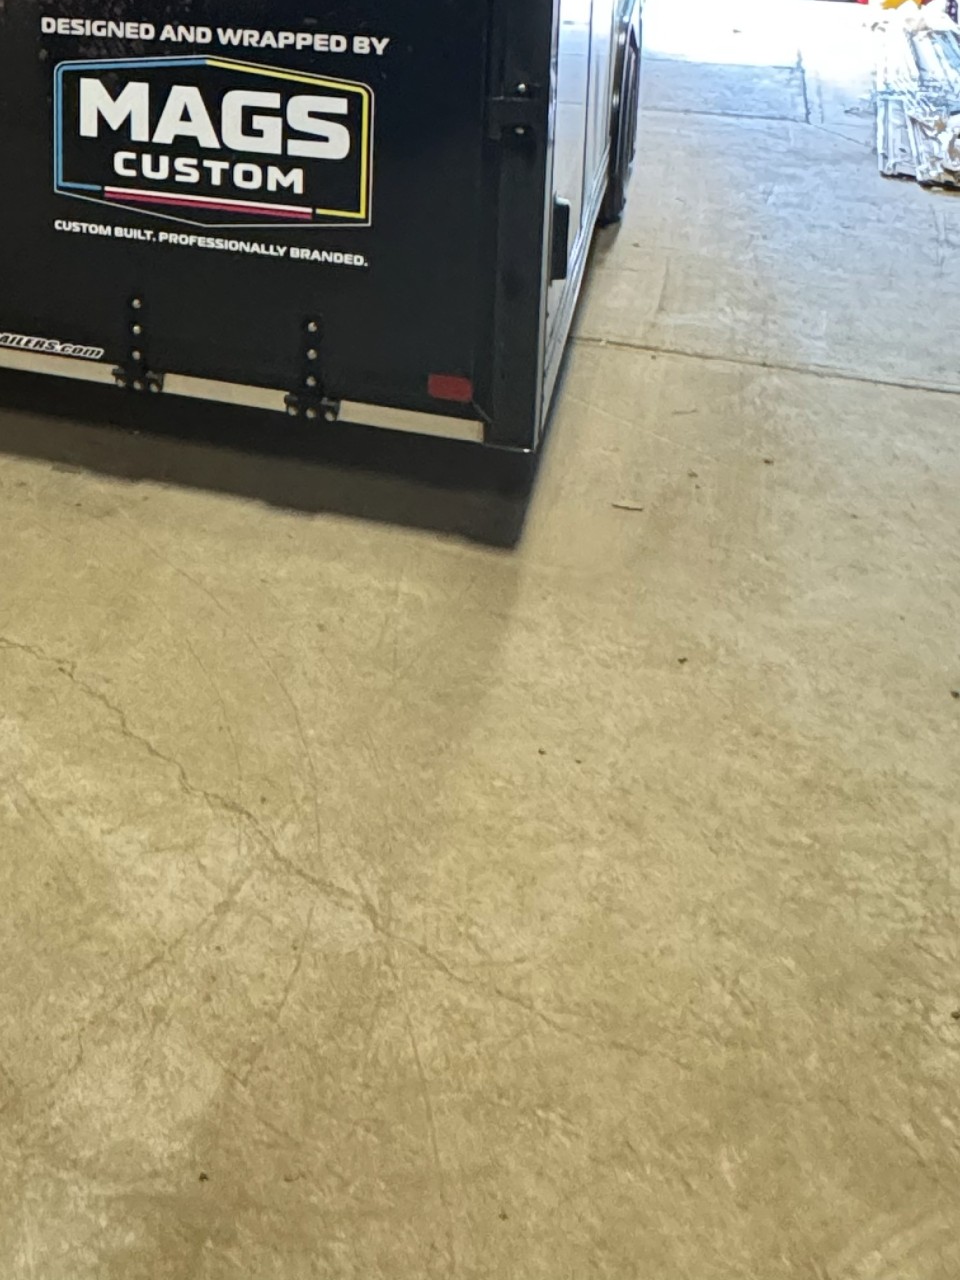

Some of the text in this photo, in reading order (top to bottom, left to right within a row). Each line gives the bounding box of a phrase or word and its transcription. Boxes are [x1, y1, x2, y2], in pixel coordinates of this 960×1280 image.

[40, 17, 390, 56] DESIGNED AND WRAPPED BY
[78, 77, 351, 160] MAGS
[113, 151, 304, 195] CUSTOM
[54, 219, 369, 267] CUSTOM BUILT. PROFESSIONALLY BRANDED.
